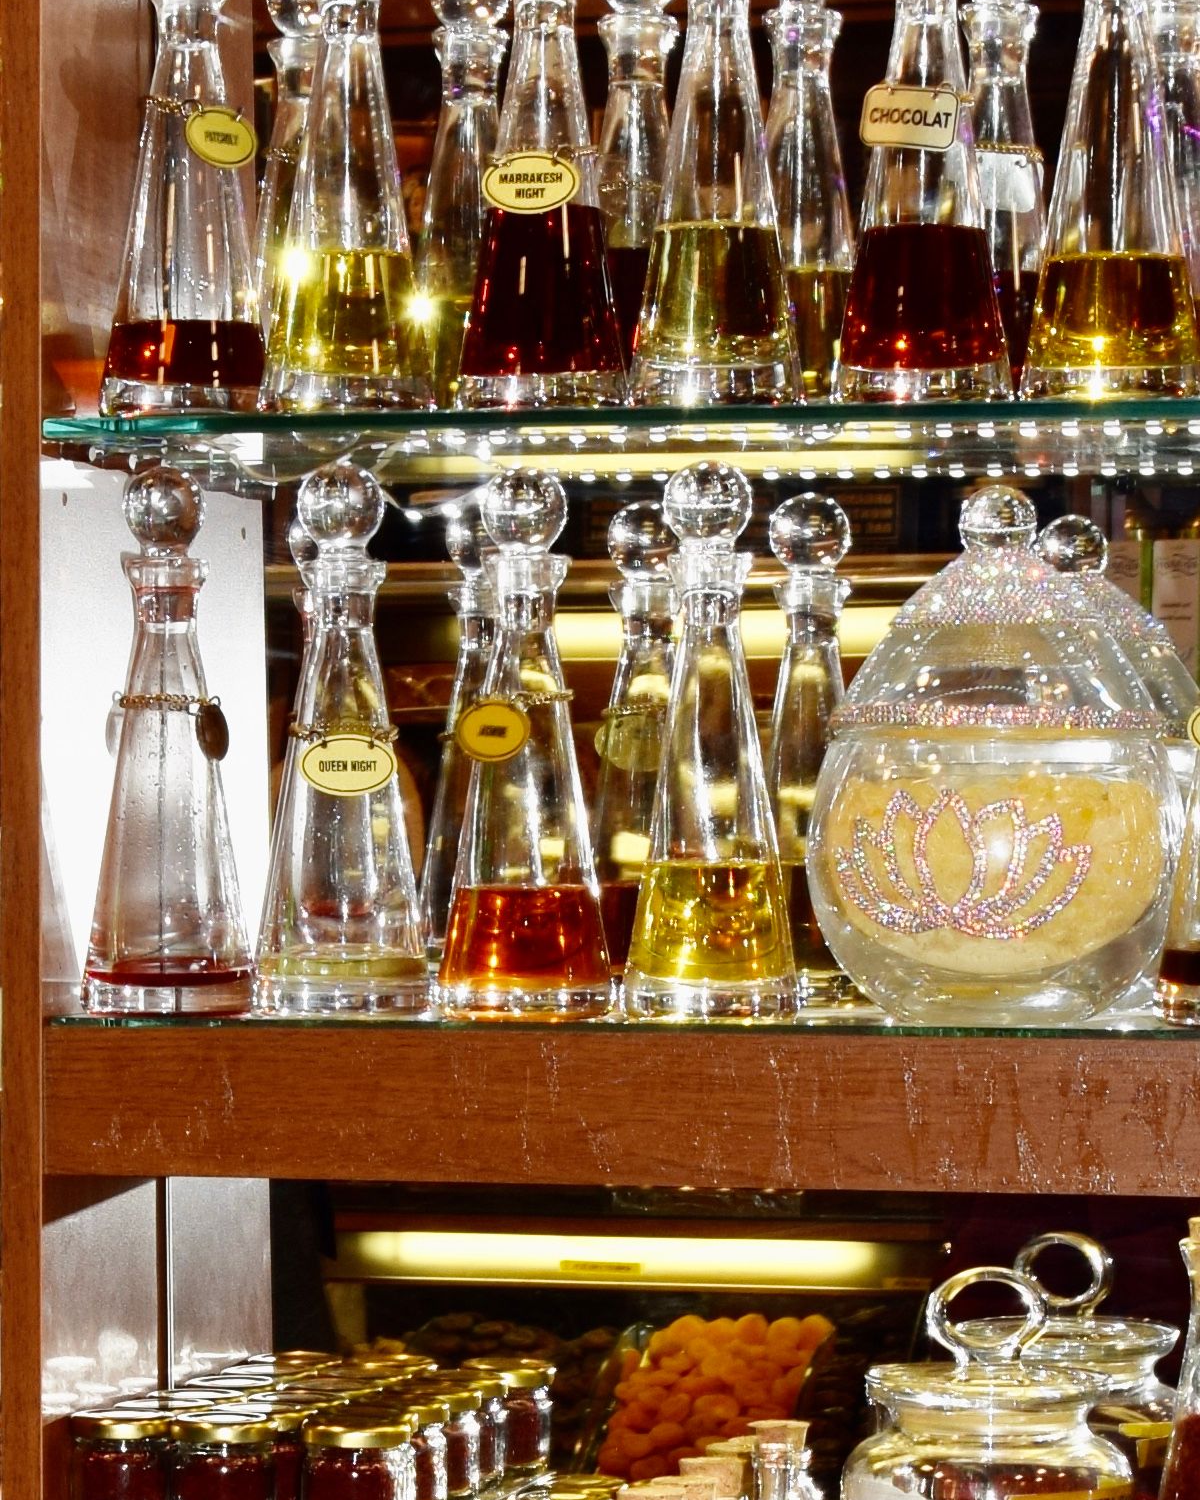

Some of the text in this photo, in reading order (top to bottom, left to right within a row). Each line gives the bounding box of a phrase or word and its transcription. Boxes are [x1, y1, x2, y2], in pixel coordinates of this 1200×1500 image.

[869, 107, 952, 129] CHOCOLAT
[499, 172, 562, 185] MARRAKESH
[515, 187, 546, 200] NIGHT
[318, 760, 377, 773] QUEEN NIGHT
